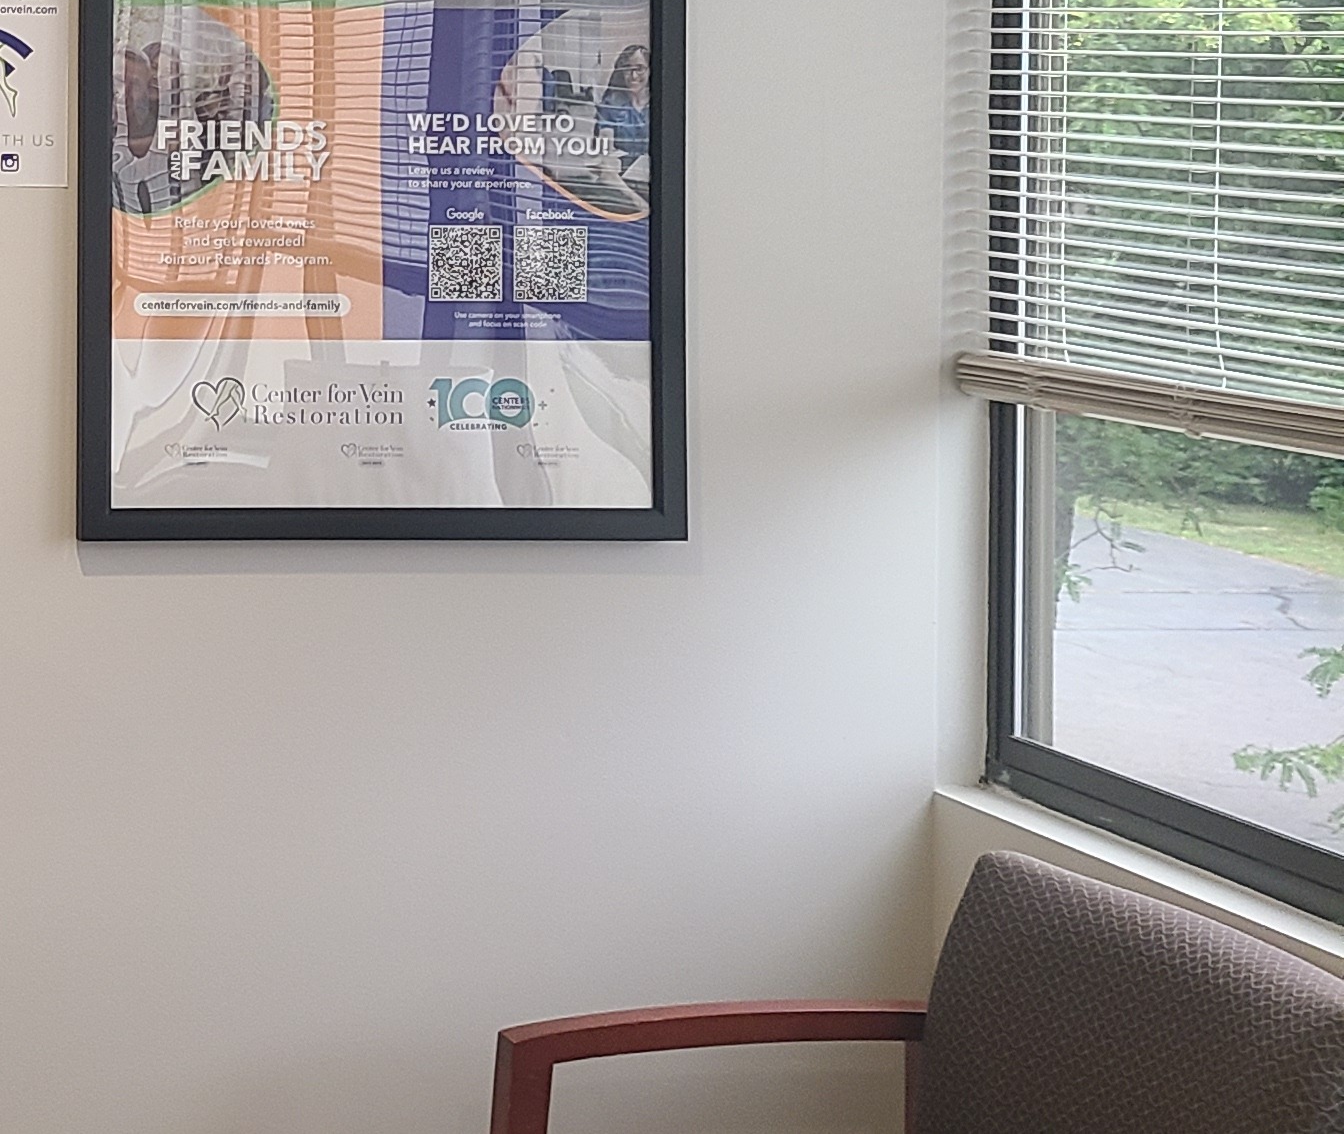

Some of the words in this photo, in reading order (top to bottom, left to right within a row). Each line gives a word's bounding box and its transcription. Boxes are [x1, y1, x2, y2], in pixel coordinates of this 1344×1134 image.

[476, 114, 536, 132] LOVE
[539, 115, 574, 132] TO
[33, 135, 54, 146] US
[157, 120, 328, 152] FRIENDS
[408, 136, 470, 155] HEAR
[476, 137, 545, 155] FROM
[551, 138, 609, 156] YOU!
[171, 152, 180, 180] AND
[182, 151, 331, 181] FAMILY
[446, 209, 484, 221] Google
[526, 209, 574, 221] facebook
[141, 300, 341, 312] centerforvein.com/friends-and-family
[252, 383, 321, 403] Center
[328, 383, 356, 403] for
[360, 384, 403, 403] Vein
[254, 404, 403, 425] Restoration
[450, 423, 507, 431] CELEBRATING
